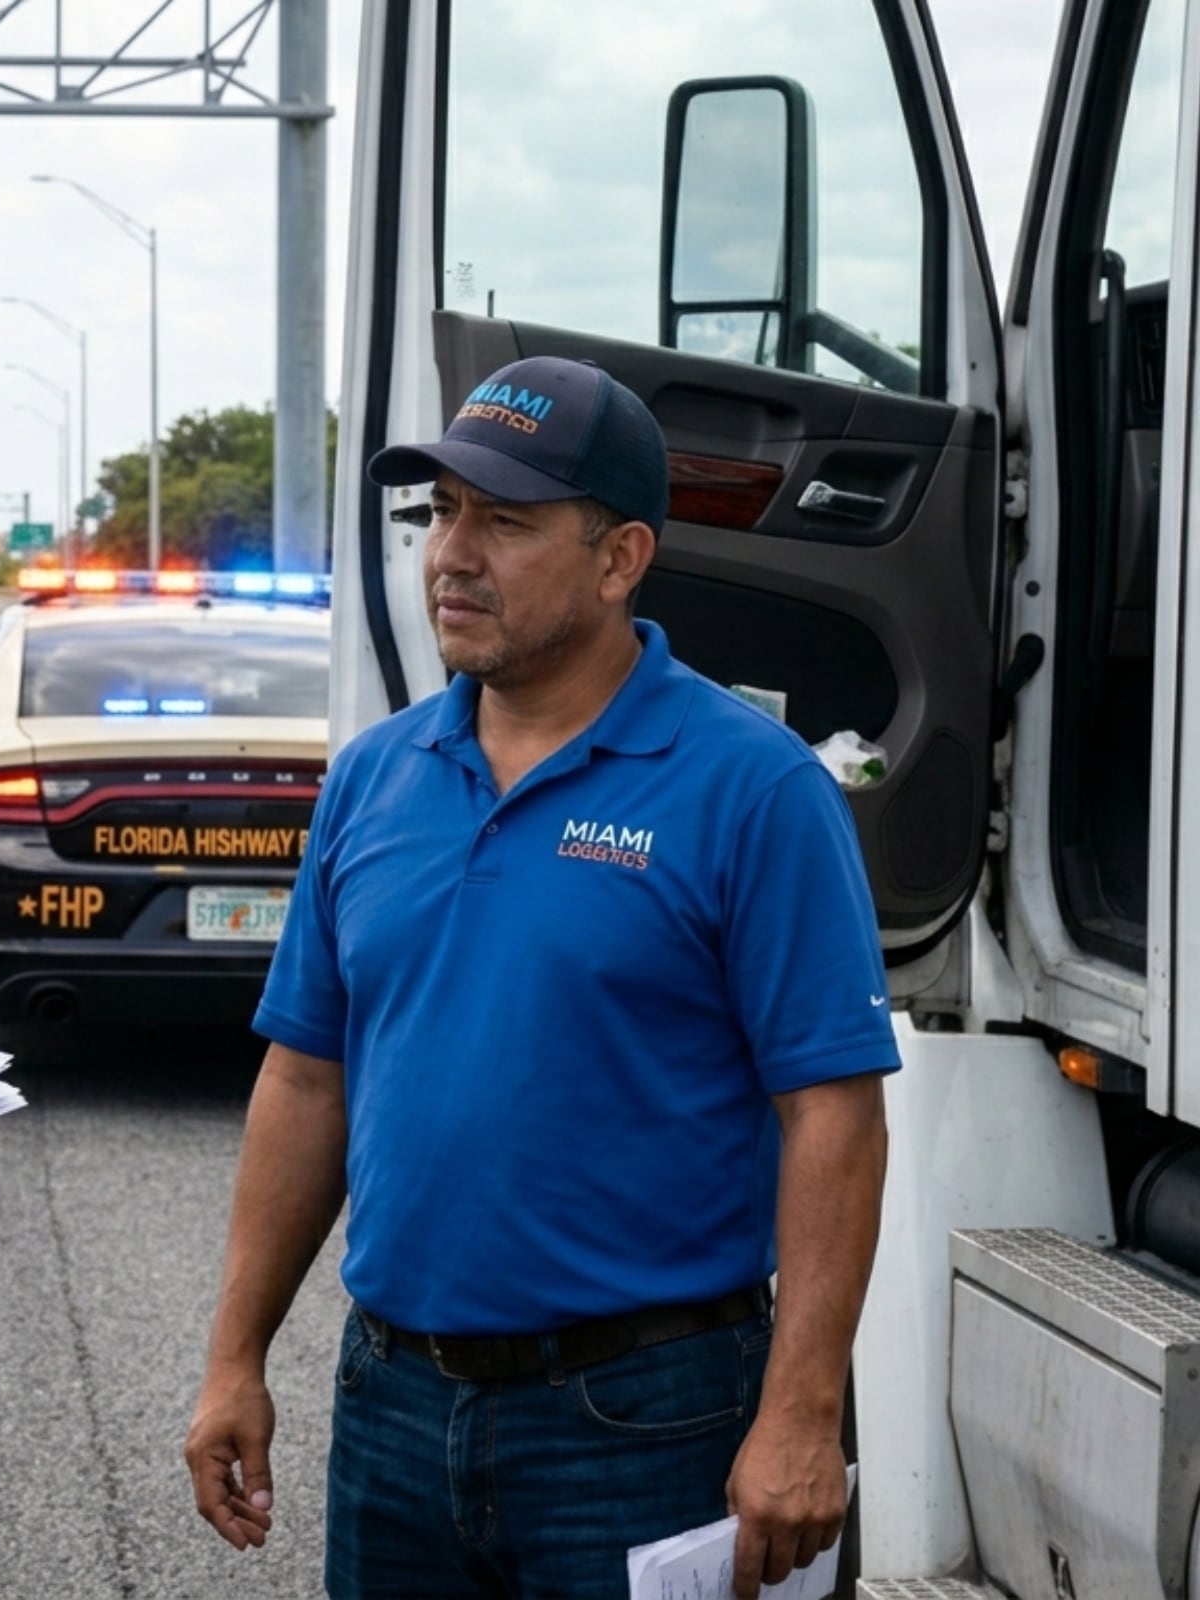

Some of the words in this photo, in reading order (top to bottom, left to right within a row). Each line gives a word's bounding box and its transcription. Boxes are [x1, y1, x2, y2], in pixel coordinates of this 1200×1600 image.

[95, 826, 189, 855] FLORIDA
[562, 818, 654, 853] MIAMI
[41, 884, 104, 929] FHP
